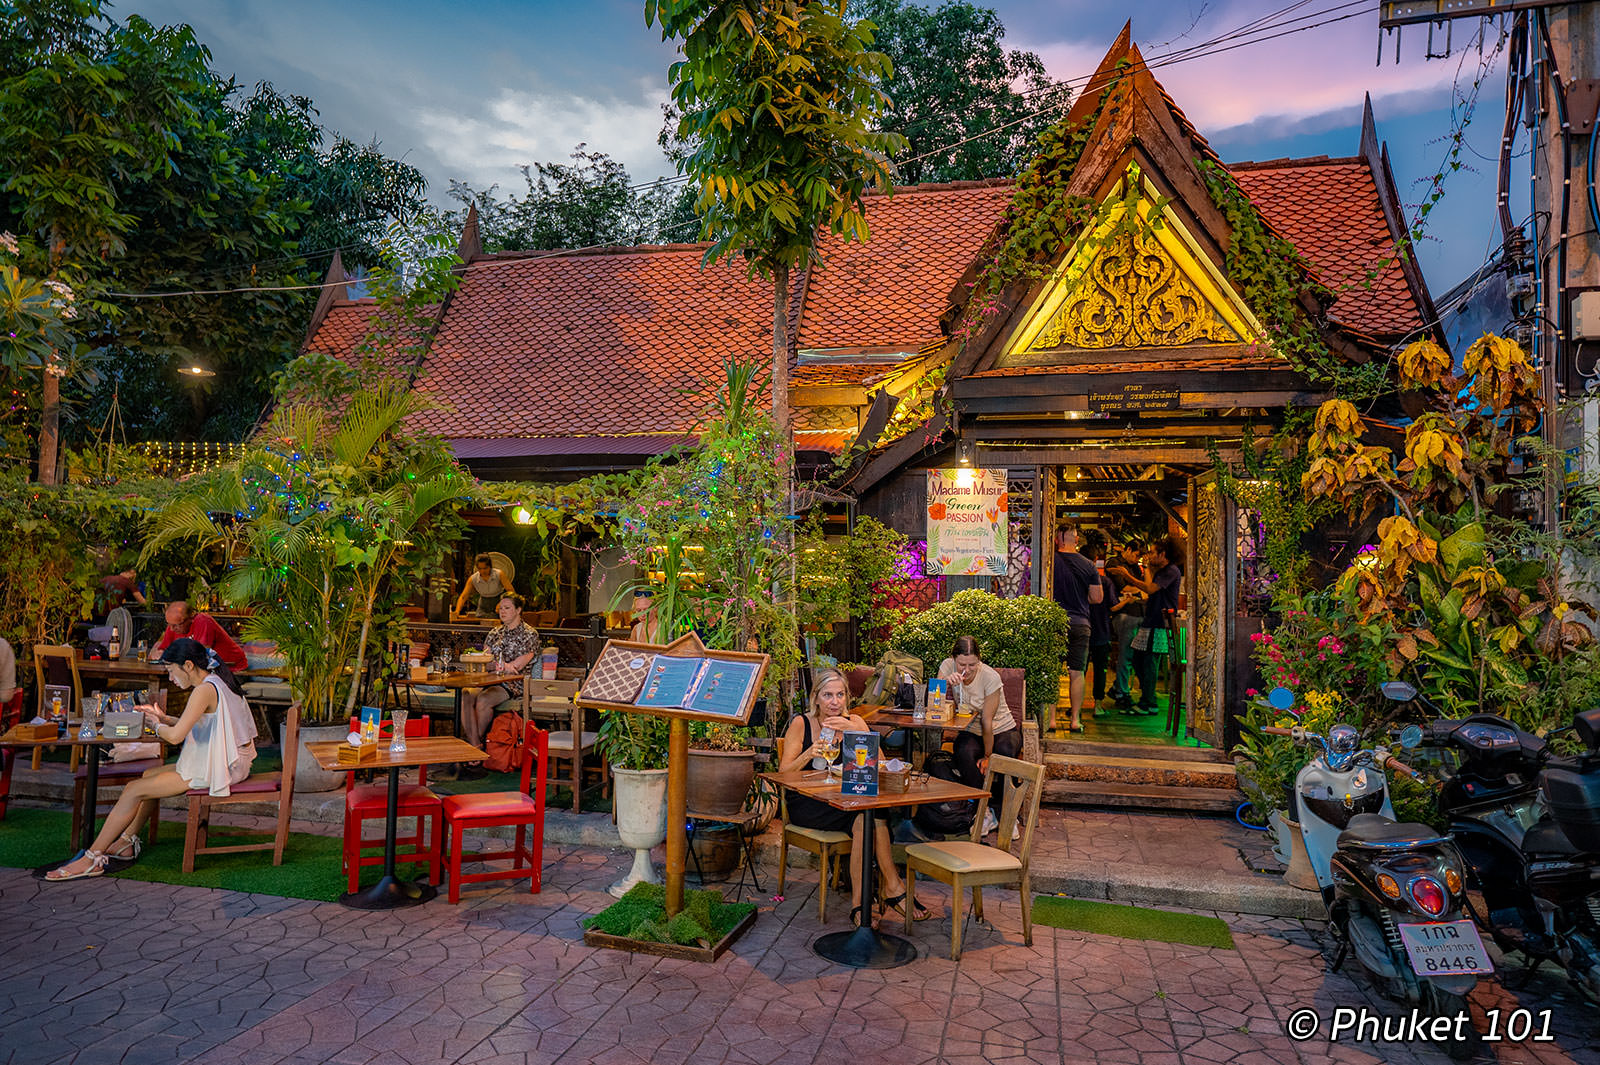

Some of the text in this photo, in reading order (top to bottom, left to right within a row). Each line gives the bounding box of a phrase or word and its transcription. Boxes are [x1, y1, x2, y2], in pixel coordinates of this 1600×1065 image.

[931, 481, 1004, 496] Madame Musur
[945, 497, 985, 511] Green
[946, 513, 984, 523] PASSION
[1415, 943, 1476, 955] สมุทรปราการ
[1425, 956, 1478, 971] 8446
